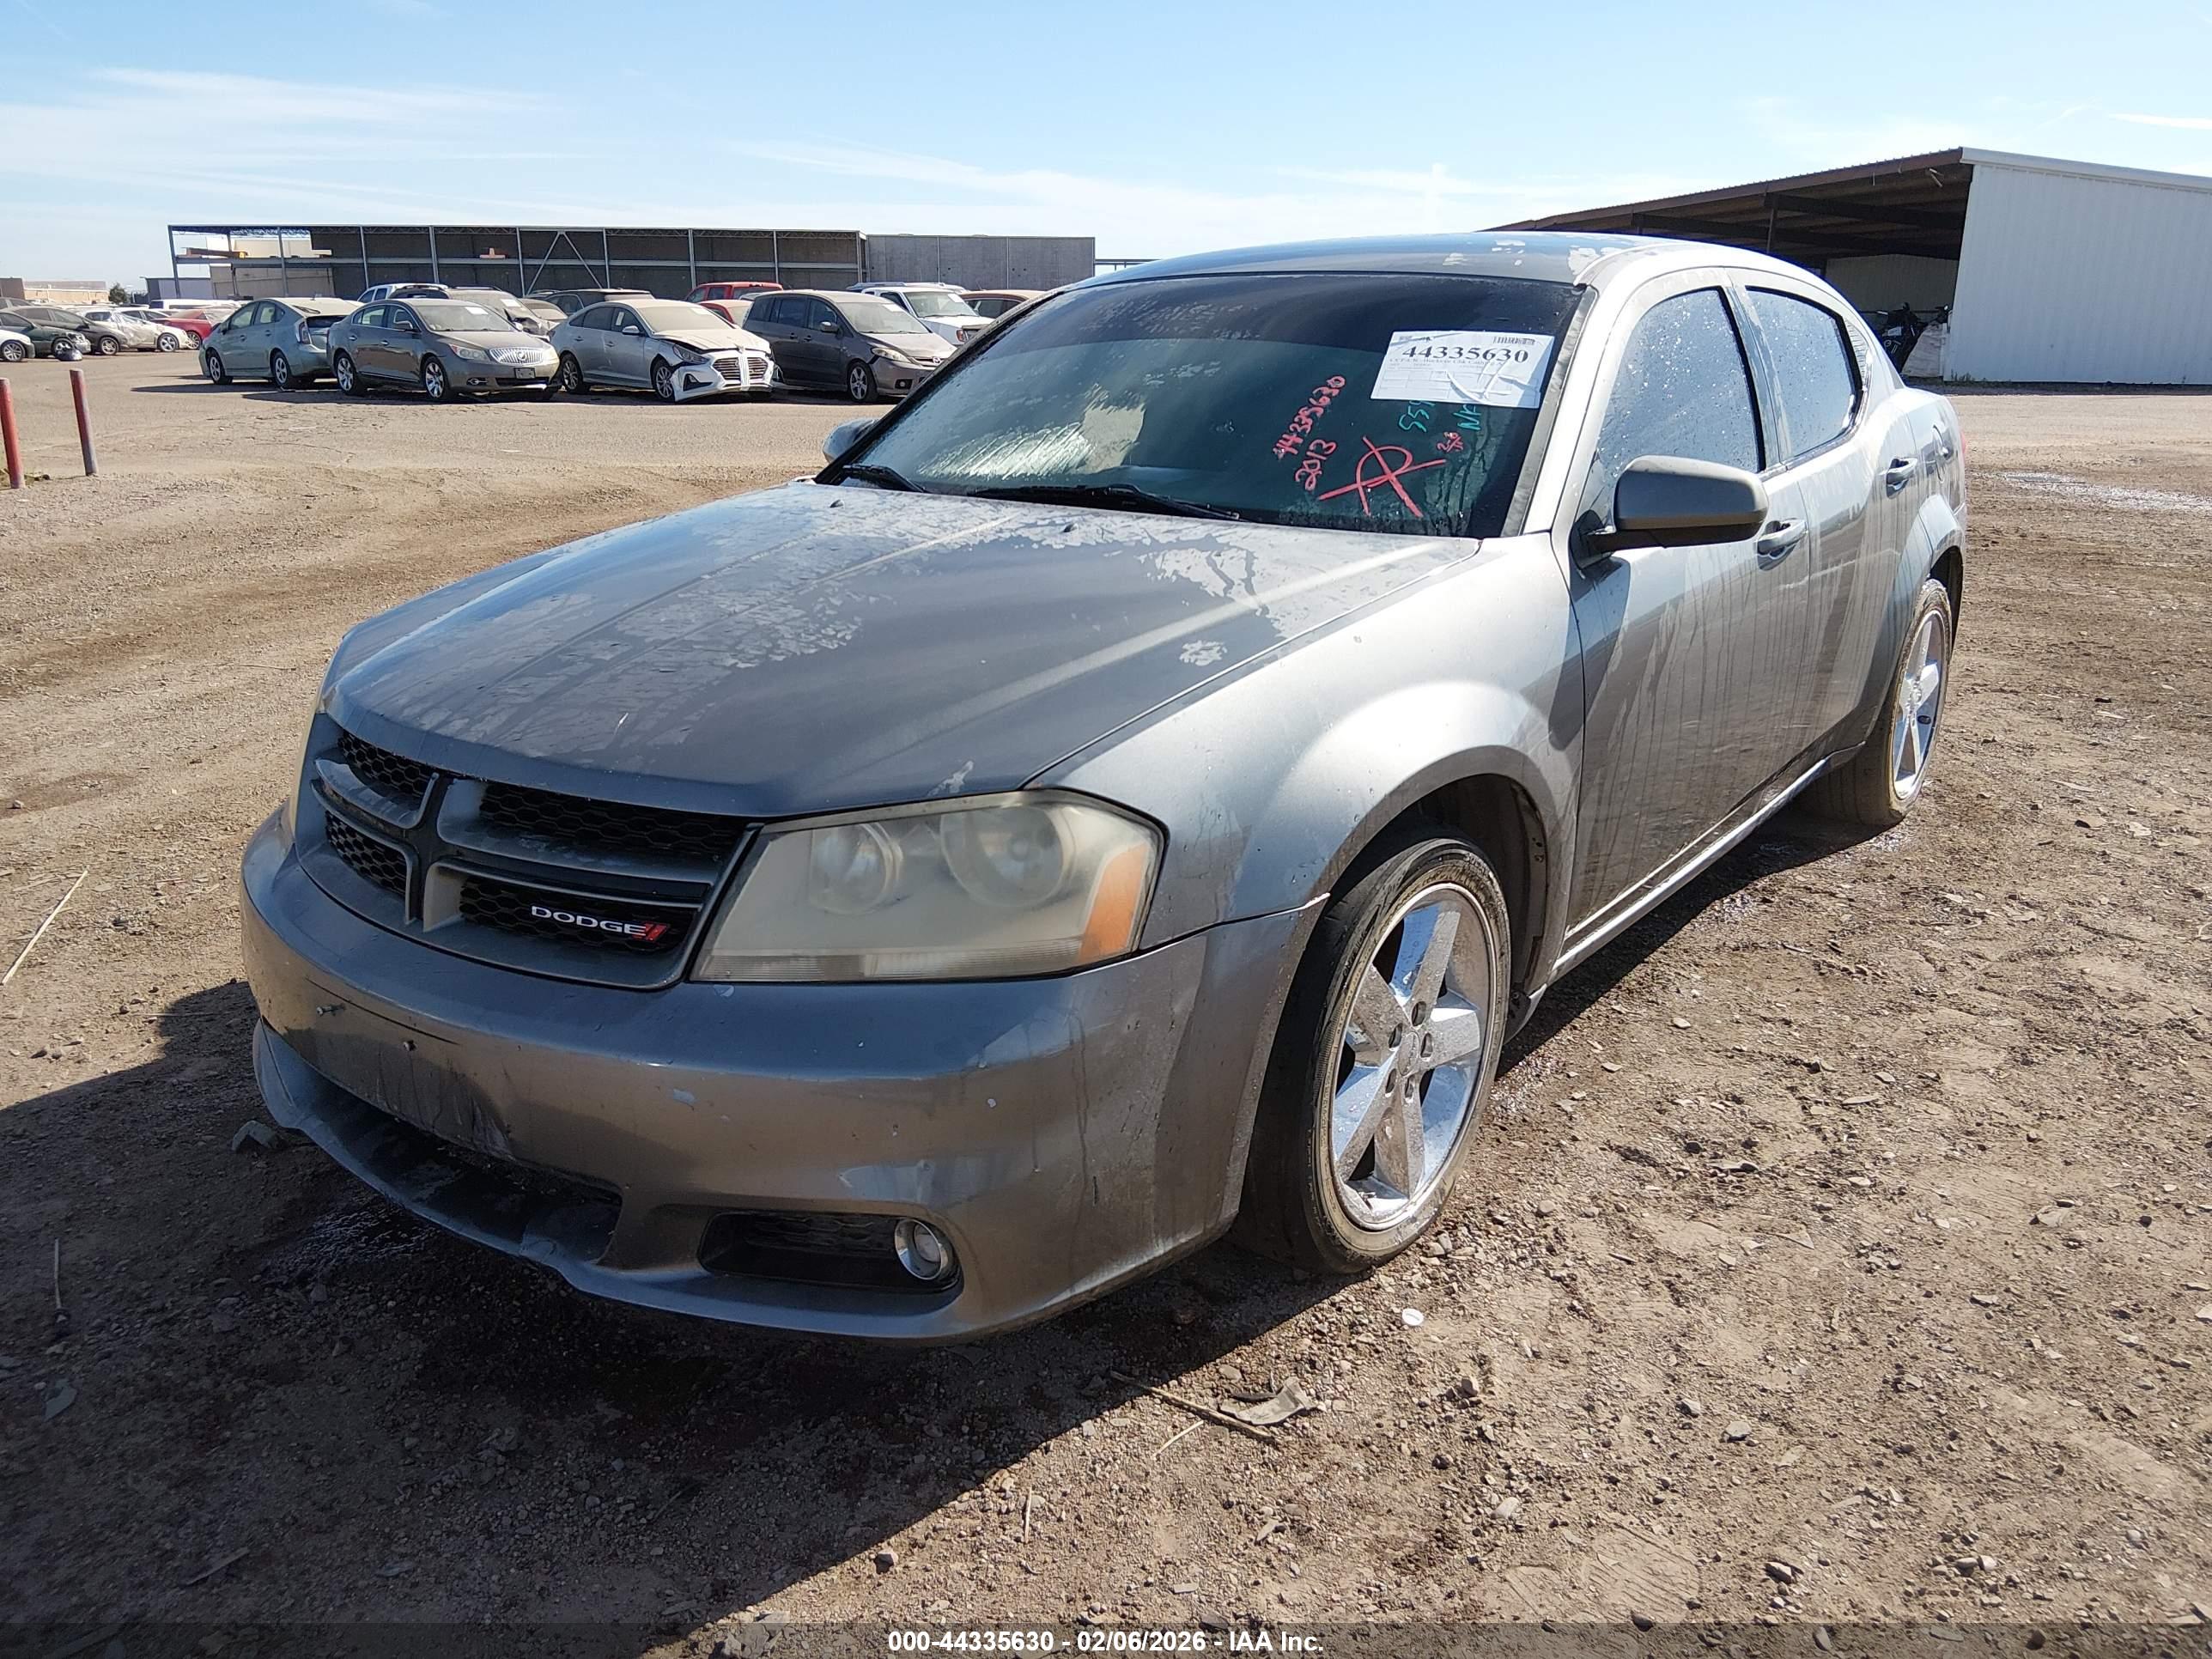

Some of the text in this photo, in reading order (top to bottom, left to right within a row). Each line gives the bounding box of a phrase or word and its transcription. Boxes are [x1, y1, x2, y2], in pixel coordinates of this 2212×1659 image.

[1402, 345, 1528, 363] 44335630
[1295, 439, 1337, 490] 2013
[532, 906, 647, 936] DODGE
